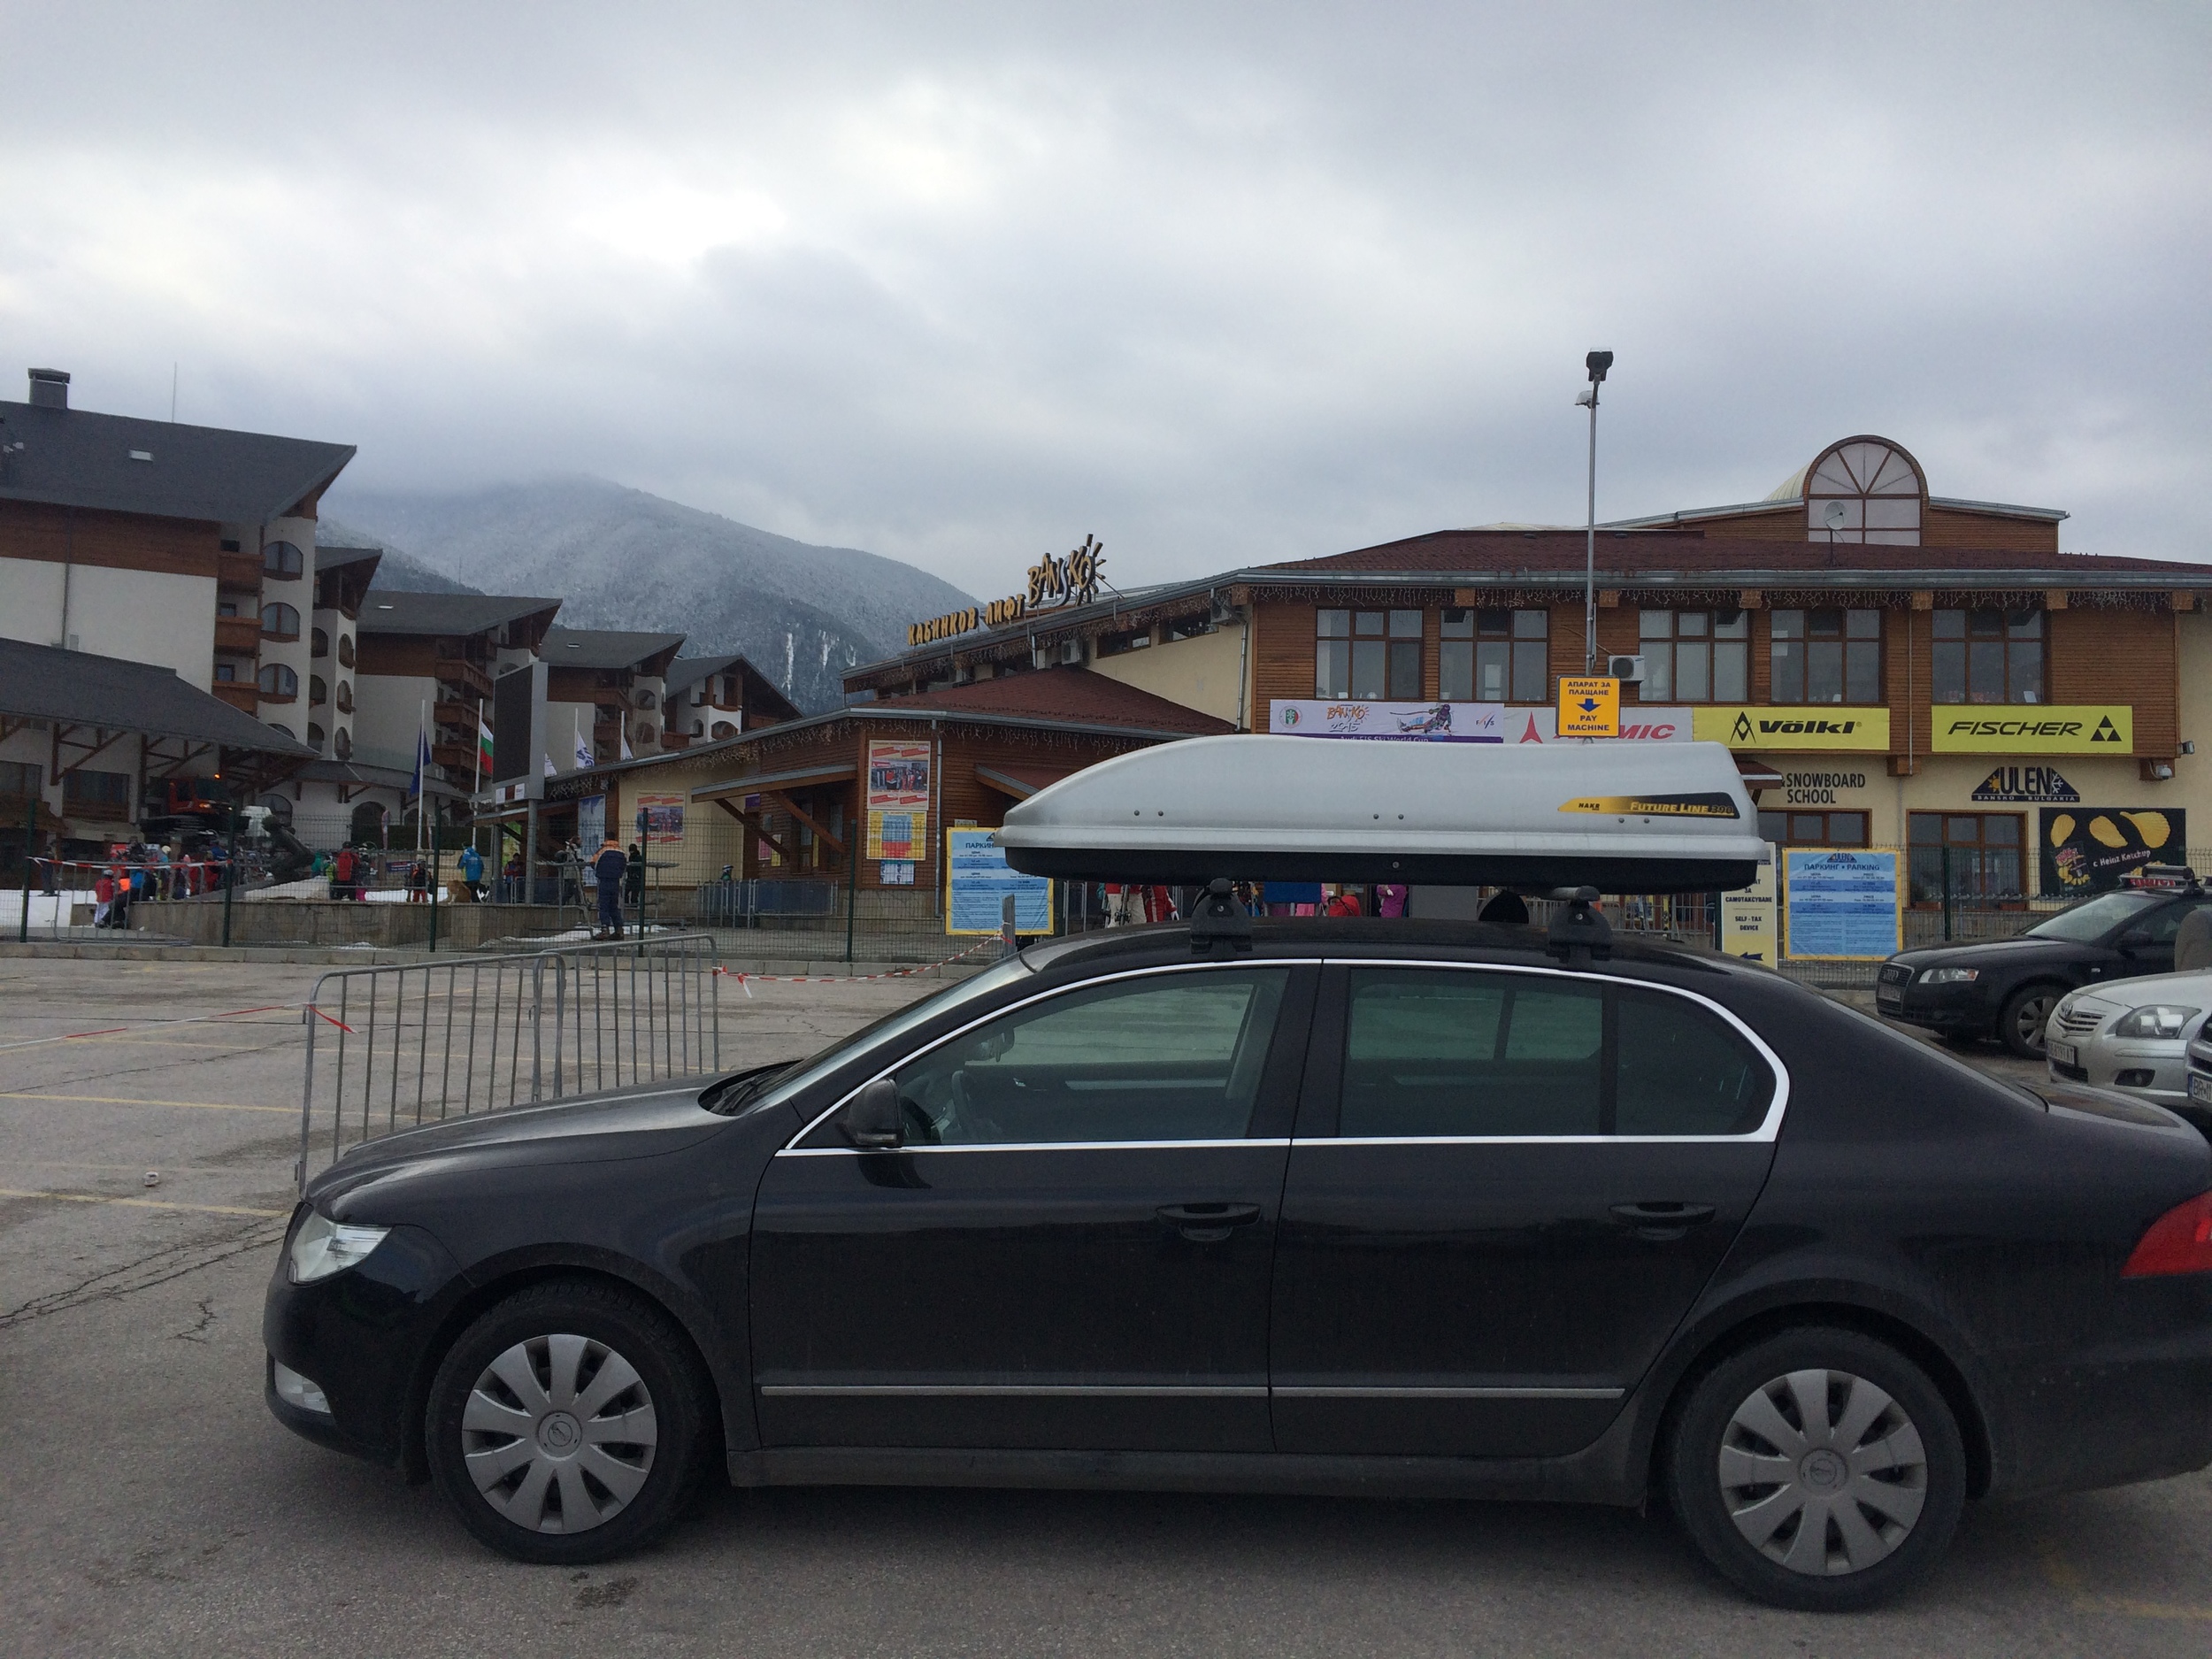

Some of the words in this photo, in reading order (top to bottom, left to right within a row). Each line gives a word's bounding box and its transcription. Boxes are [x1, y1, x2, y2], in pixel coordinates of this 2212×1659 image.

[1027, 545, 1096, 609] BANSKO
[908, 607, 979, 646] КАБИНКОВ
[985, 594, 1025, 625] ЛИФТ
[1948, 721, 2083, 736] FISCHER
[1786, 773, 1865, 787] SNOWBOARD
[2001, 767, 2052, 795] ULEN
[1787, 789, 1836, 803] SCHOOL
[1630, 802, 1678, 812] FUTURE
[1680, 803, 1709, 813] LINE
[2100, 856, 2121, 866] Heinz
[2121, 849, 2151, 862] Ketchup
